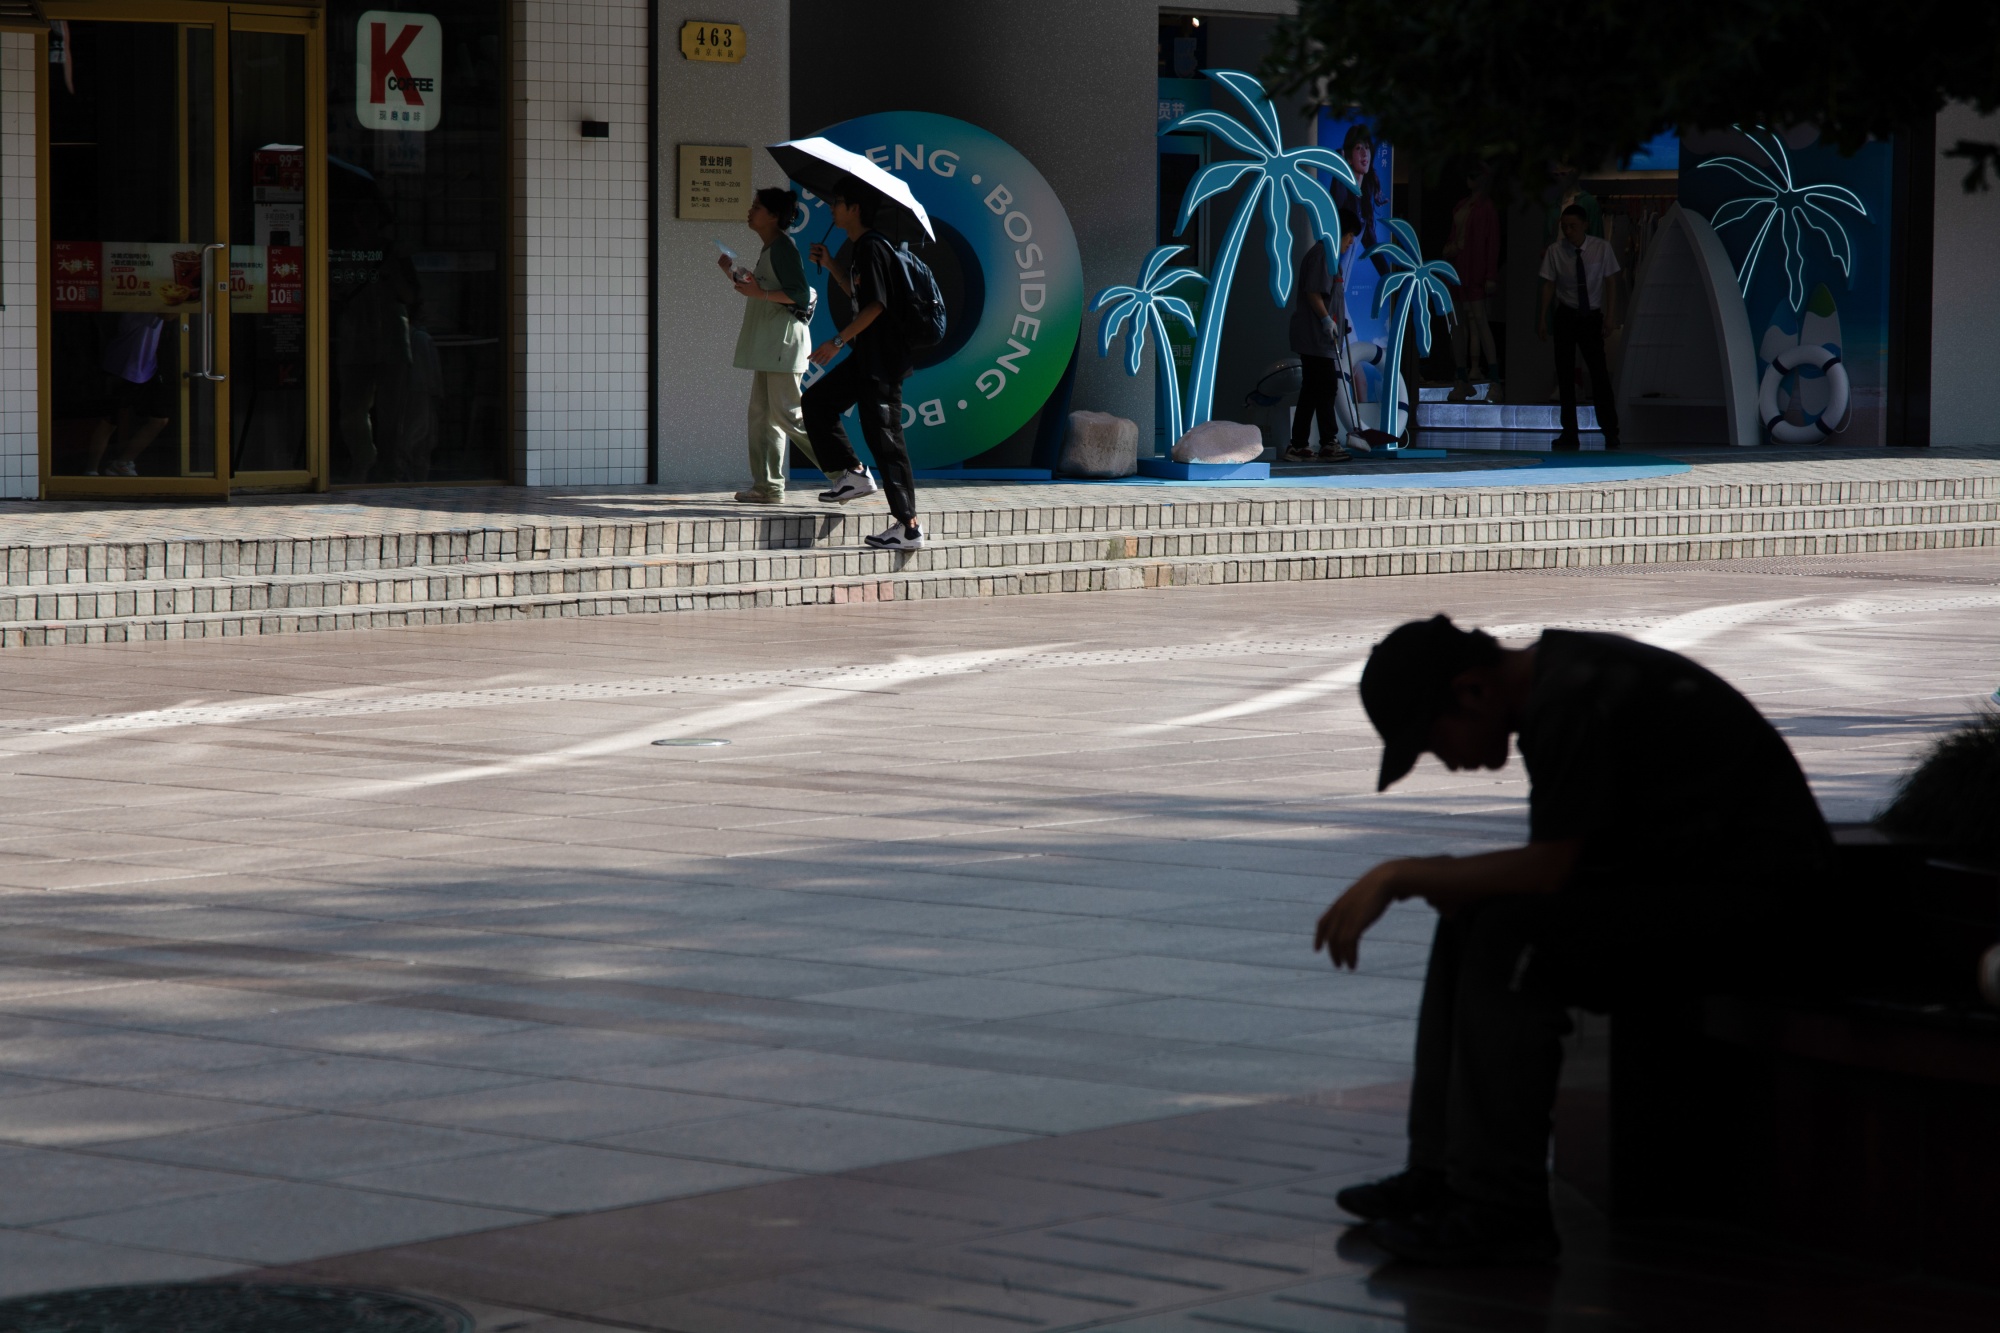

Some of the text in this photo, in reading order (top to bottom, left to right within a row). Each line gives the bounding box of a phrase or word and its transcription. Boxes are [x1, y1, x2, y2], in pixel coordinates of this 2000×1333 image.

[696, 26, 732, 48] 463
[694, 47, 734, 59] 南京东路
[370, 22, 424, 105] K
[388, 76, 434, 92] COFFEE
[1158, 101, 1185, 120] 员节
[699, 155, 733, 167] 营业时间
[58, 258, 95, 272] 大神卡
[273, 263, 299, 275] 大神卡
[56, 285, 78, 301] 10
[270, 288, 286, 304] 10
[975, 184, 1046, 399] BOSIDENG
[1171, 344, 1192, 357] 司登
